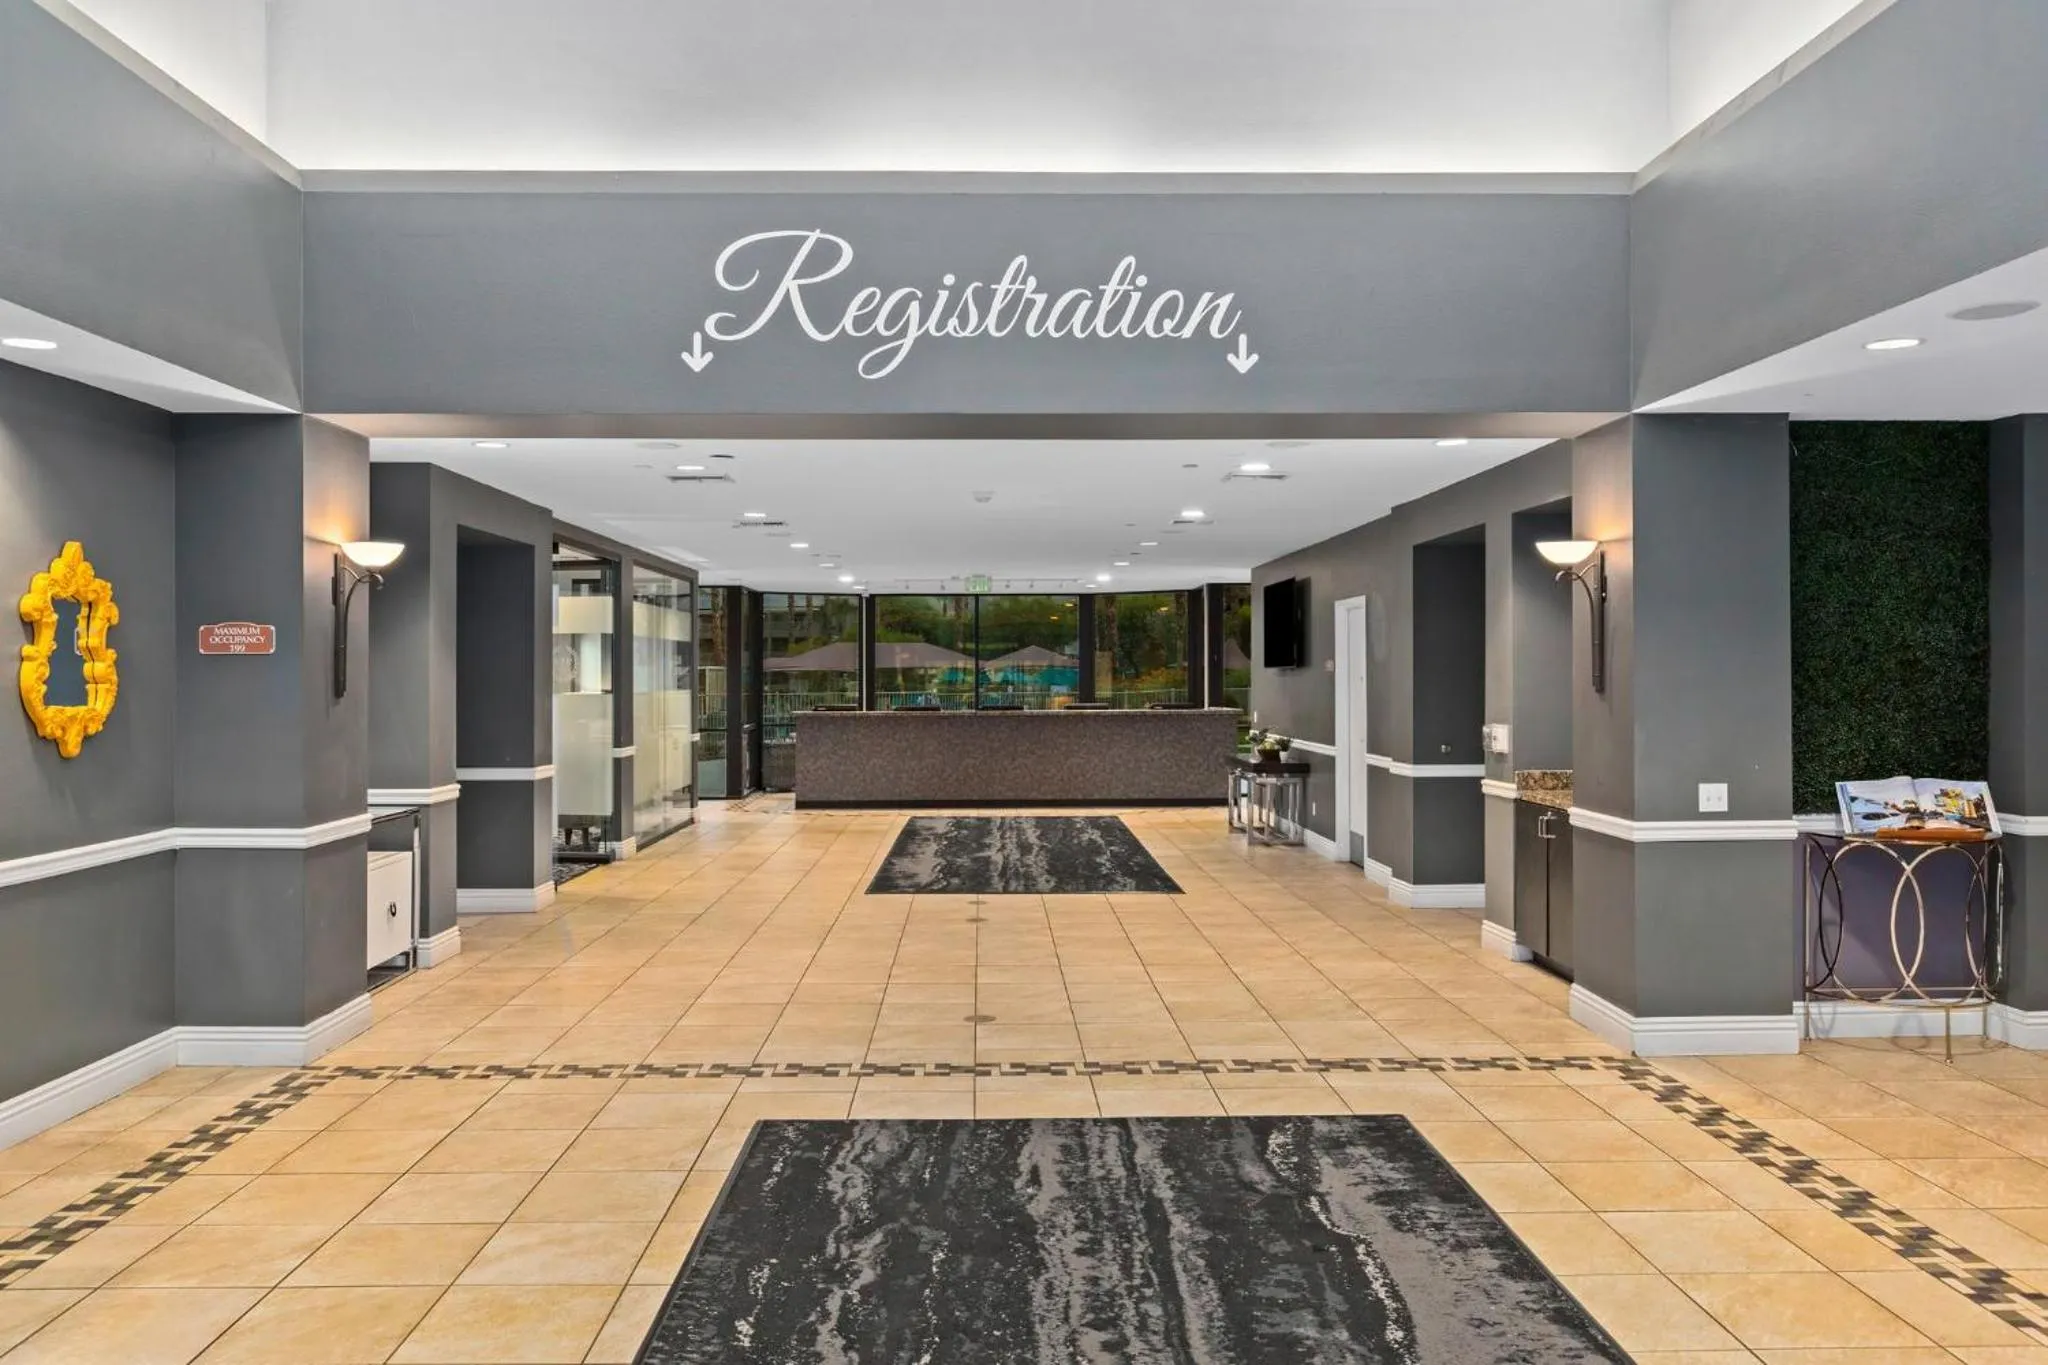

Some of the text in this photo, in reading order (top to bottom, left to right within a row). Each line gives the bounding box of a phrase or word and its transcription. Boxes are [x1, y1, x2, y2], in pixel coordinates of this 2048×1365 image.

[704, 228, 1242, 379] Registration
[213, 626, 260, 635] MAXIMUM
[209, 635, 266, 644] OCCUPANCY
